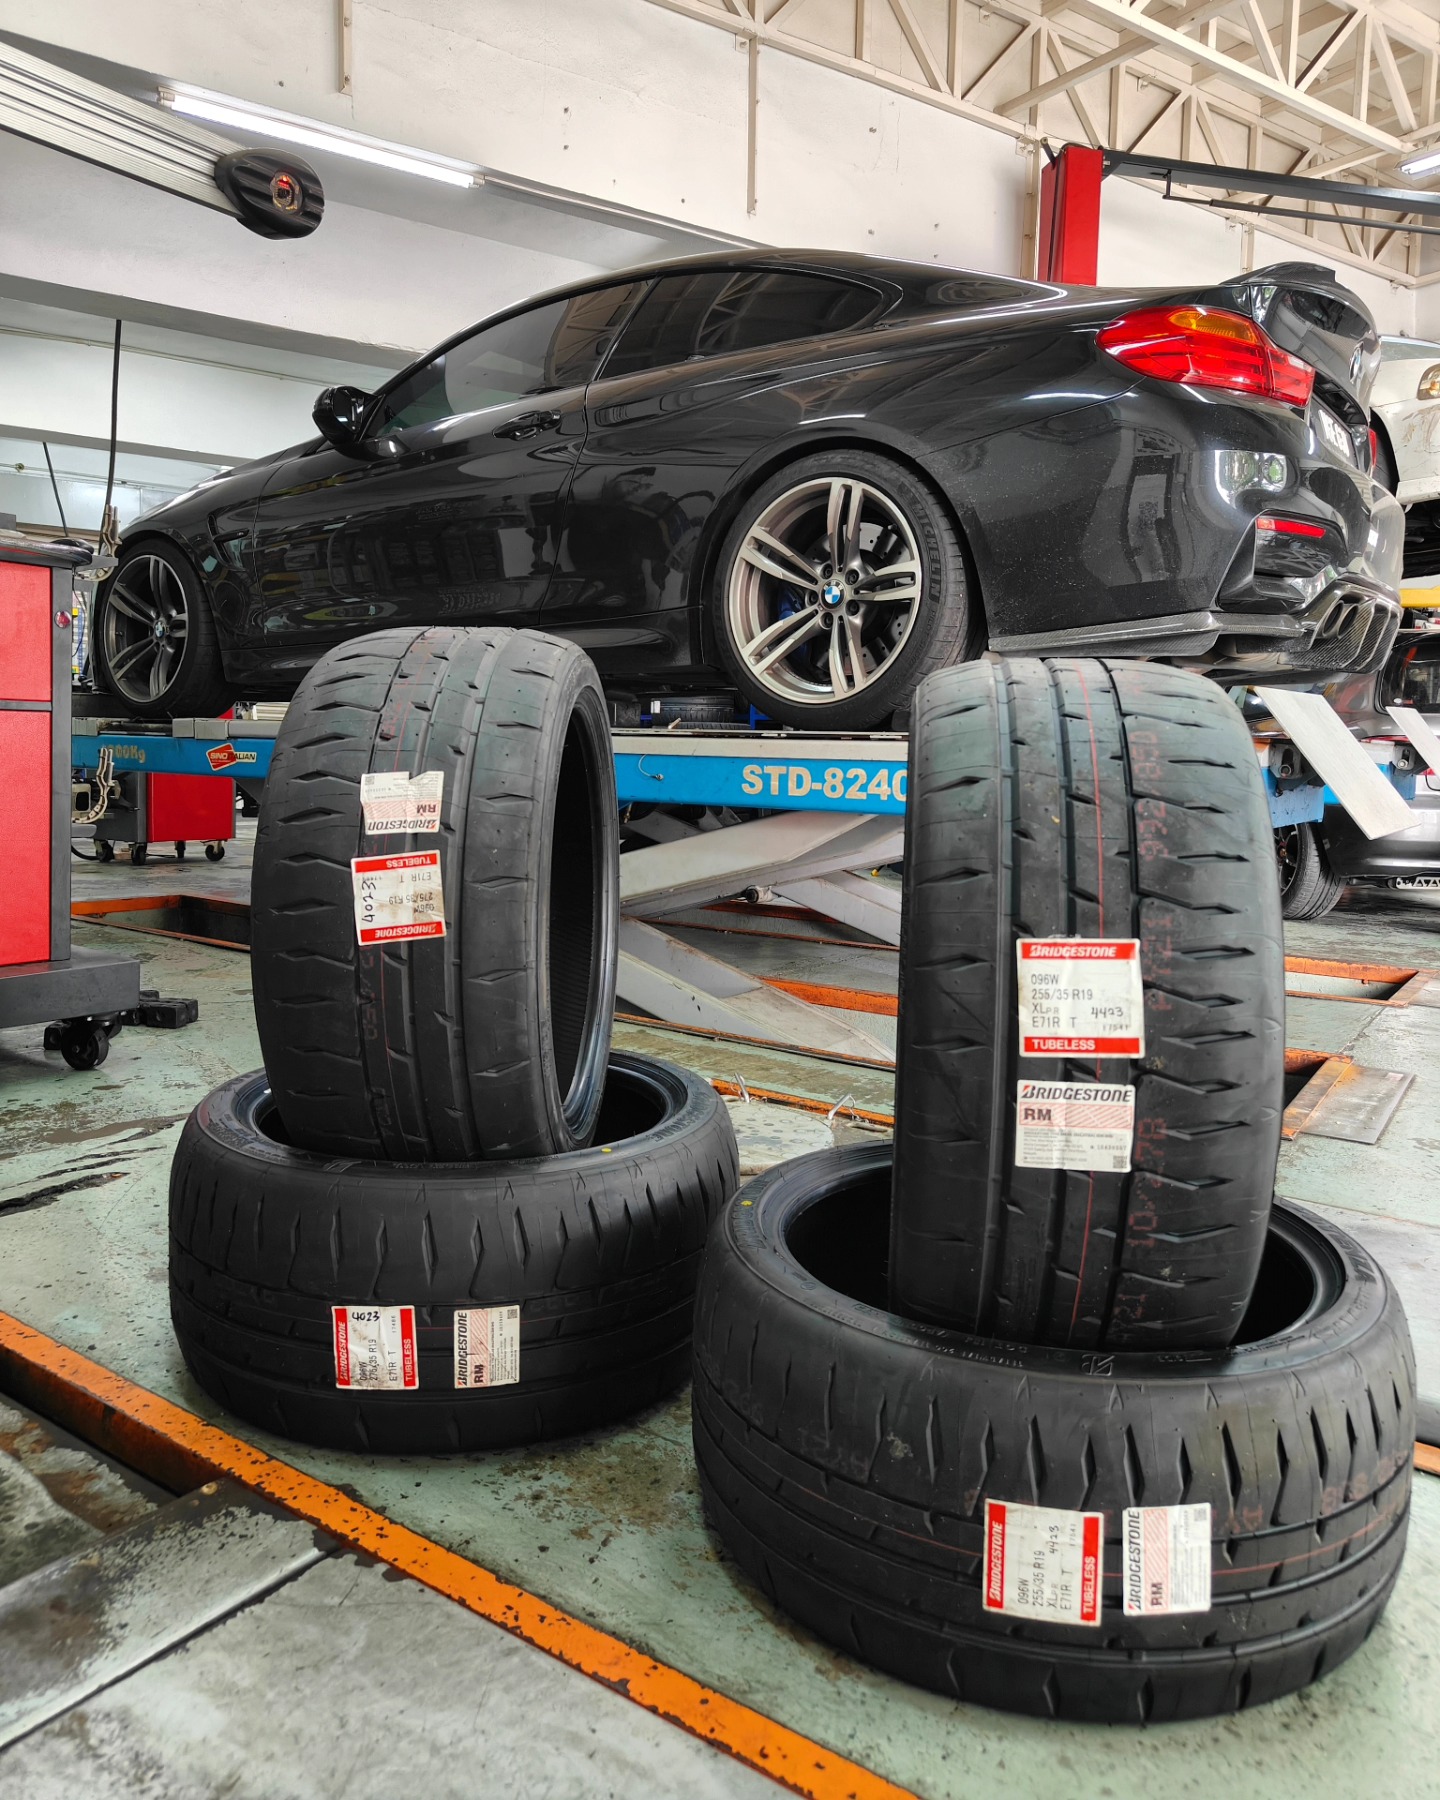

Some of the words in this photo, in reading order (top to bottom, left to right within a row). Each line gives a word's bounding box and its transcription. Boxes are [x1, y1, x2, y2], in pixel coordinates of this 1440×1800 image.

[912, 503, 941, 597] MICHELIN
[416, 804, 437, 814] RM
[386, 856, 431, 868] TUBELESS
[411, 871, 431, 882] E71R
[361, 881, 376, 923] 4023
[375, 923, 437, 939] BRIDGESTONE
[1029, 944, 1117, 958] BRIDGESTONE
[1031, 974, 1059, 985] 096W
[1031, 989, 1069, 1001] 255/35
[1072, 989, 1093, 1001] R19
[1032, 1016, 1061, 1028] E71R
[1069, 1017, 1077, 1028] T
[1091, 1007, 1124, 1020] 4423
[1031, 1038, 1096, 1051] TUBELESS
[1021, 1084, 1133, 1103] BRIDGESTONE
[1023, 1107, 1052, 1121] RM
[352, 1310, 381, 1323] 4023
[338, 1321, 348, 1380] BRIDGESTONE
[368, 1338, 377, 1353] R19
[457, 1312, 469, 1386] BRIDGESTONE
[404, 1338, 413, 1381] TUBELESS
[388, 1361, 398, 1381] E71R
[473, 1363, 484, 1384] RM
[1047, 1524, 1060, 1555] 4423
[988, 1520, 1004, 1602] BRIDGESTONE
[1031, 1550, 1045, 1569] R19
[1127, 1510, 1142, 1611] BRIDGESTONE
[1061, 1567, 1073, 1577] T
[1017, 1577, 1029, 1605] 096W
[1031, 1571, 1045, 1607] 255/35
[1083, 1555, 1096, 1614] TUBELESS
[1060, 1584, 1074, 1611] E71R
[1151, 1582, 1163, 1607] RM
